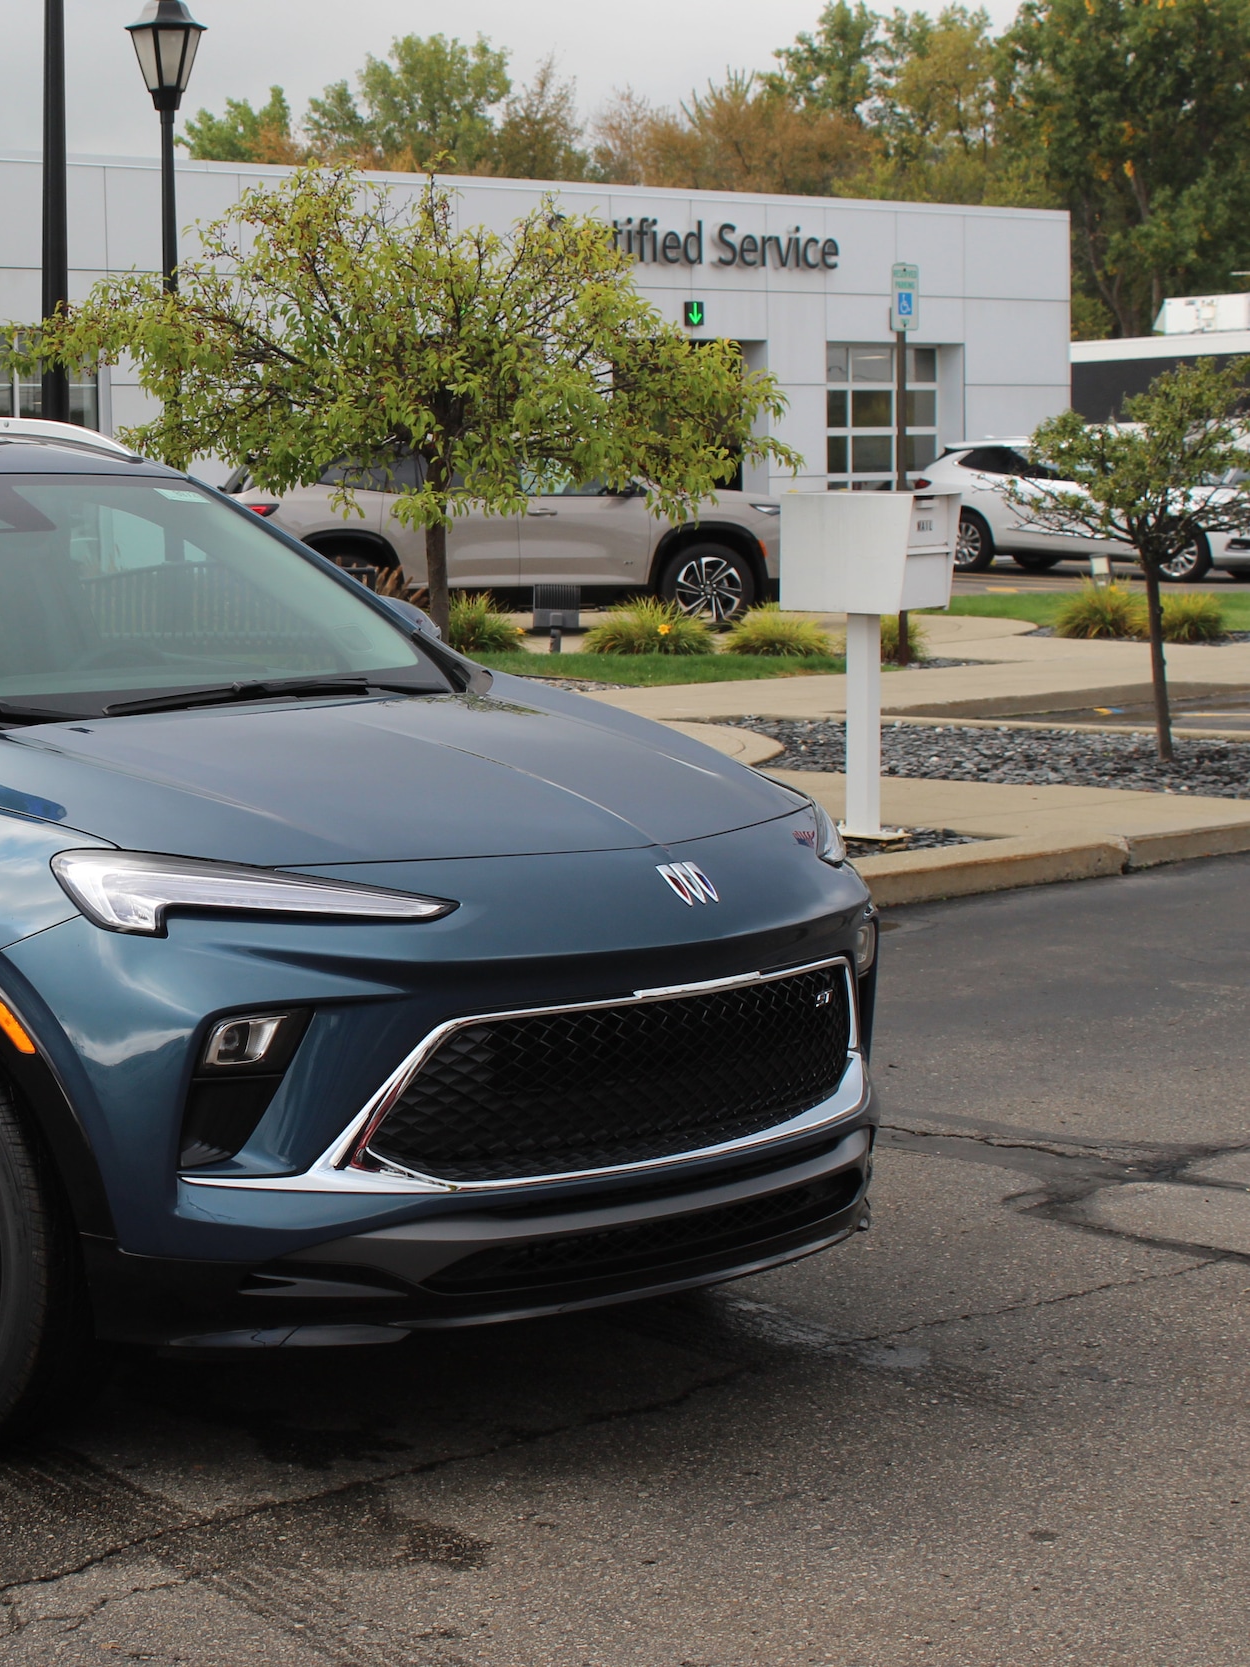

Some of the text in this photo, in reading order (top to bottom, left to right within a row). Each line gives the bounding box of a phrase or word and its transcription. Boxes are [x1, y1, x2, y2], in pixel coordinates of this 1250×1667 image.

[547, 213, 840, 270] tified Service
[917, 519, 933, 532] MAIL
[815, 989, 834, 1008] ST
